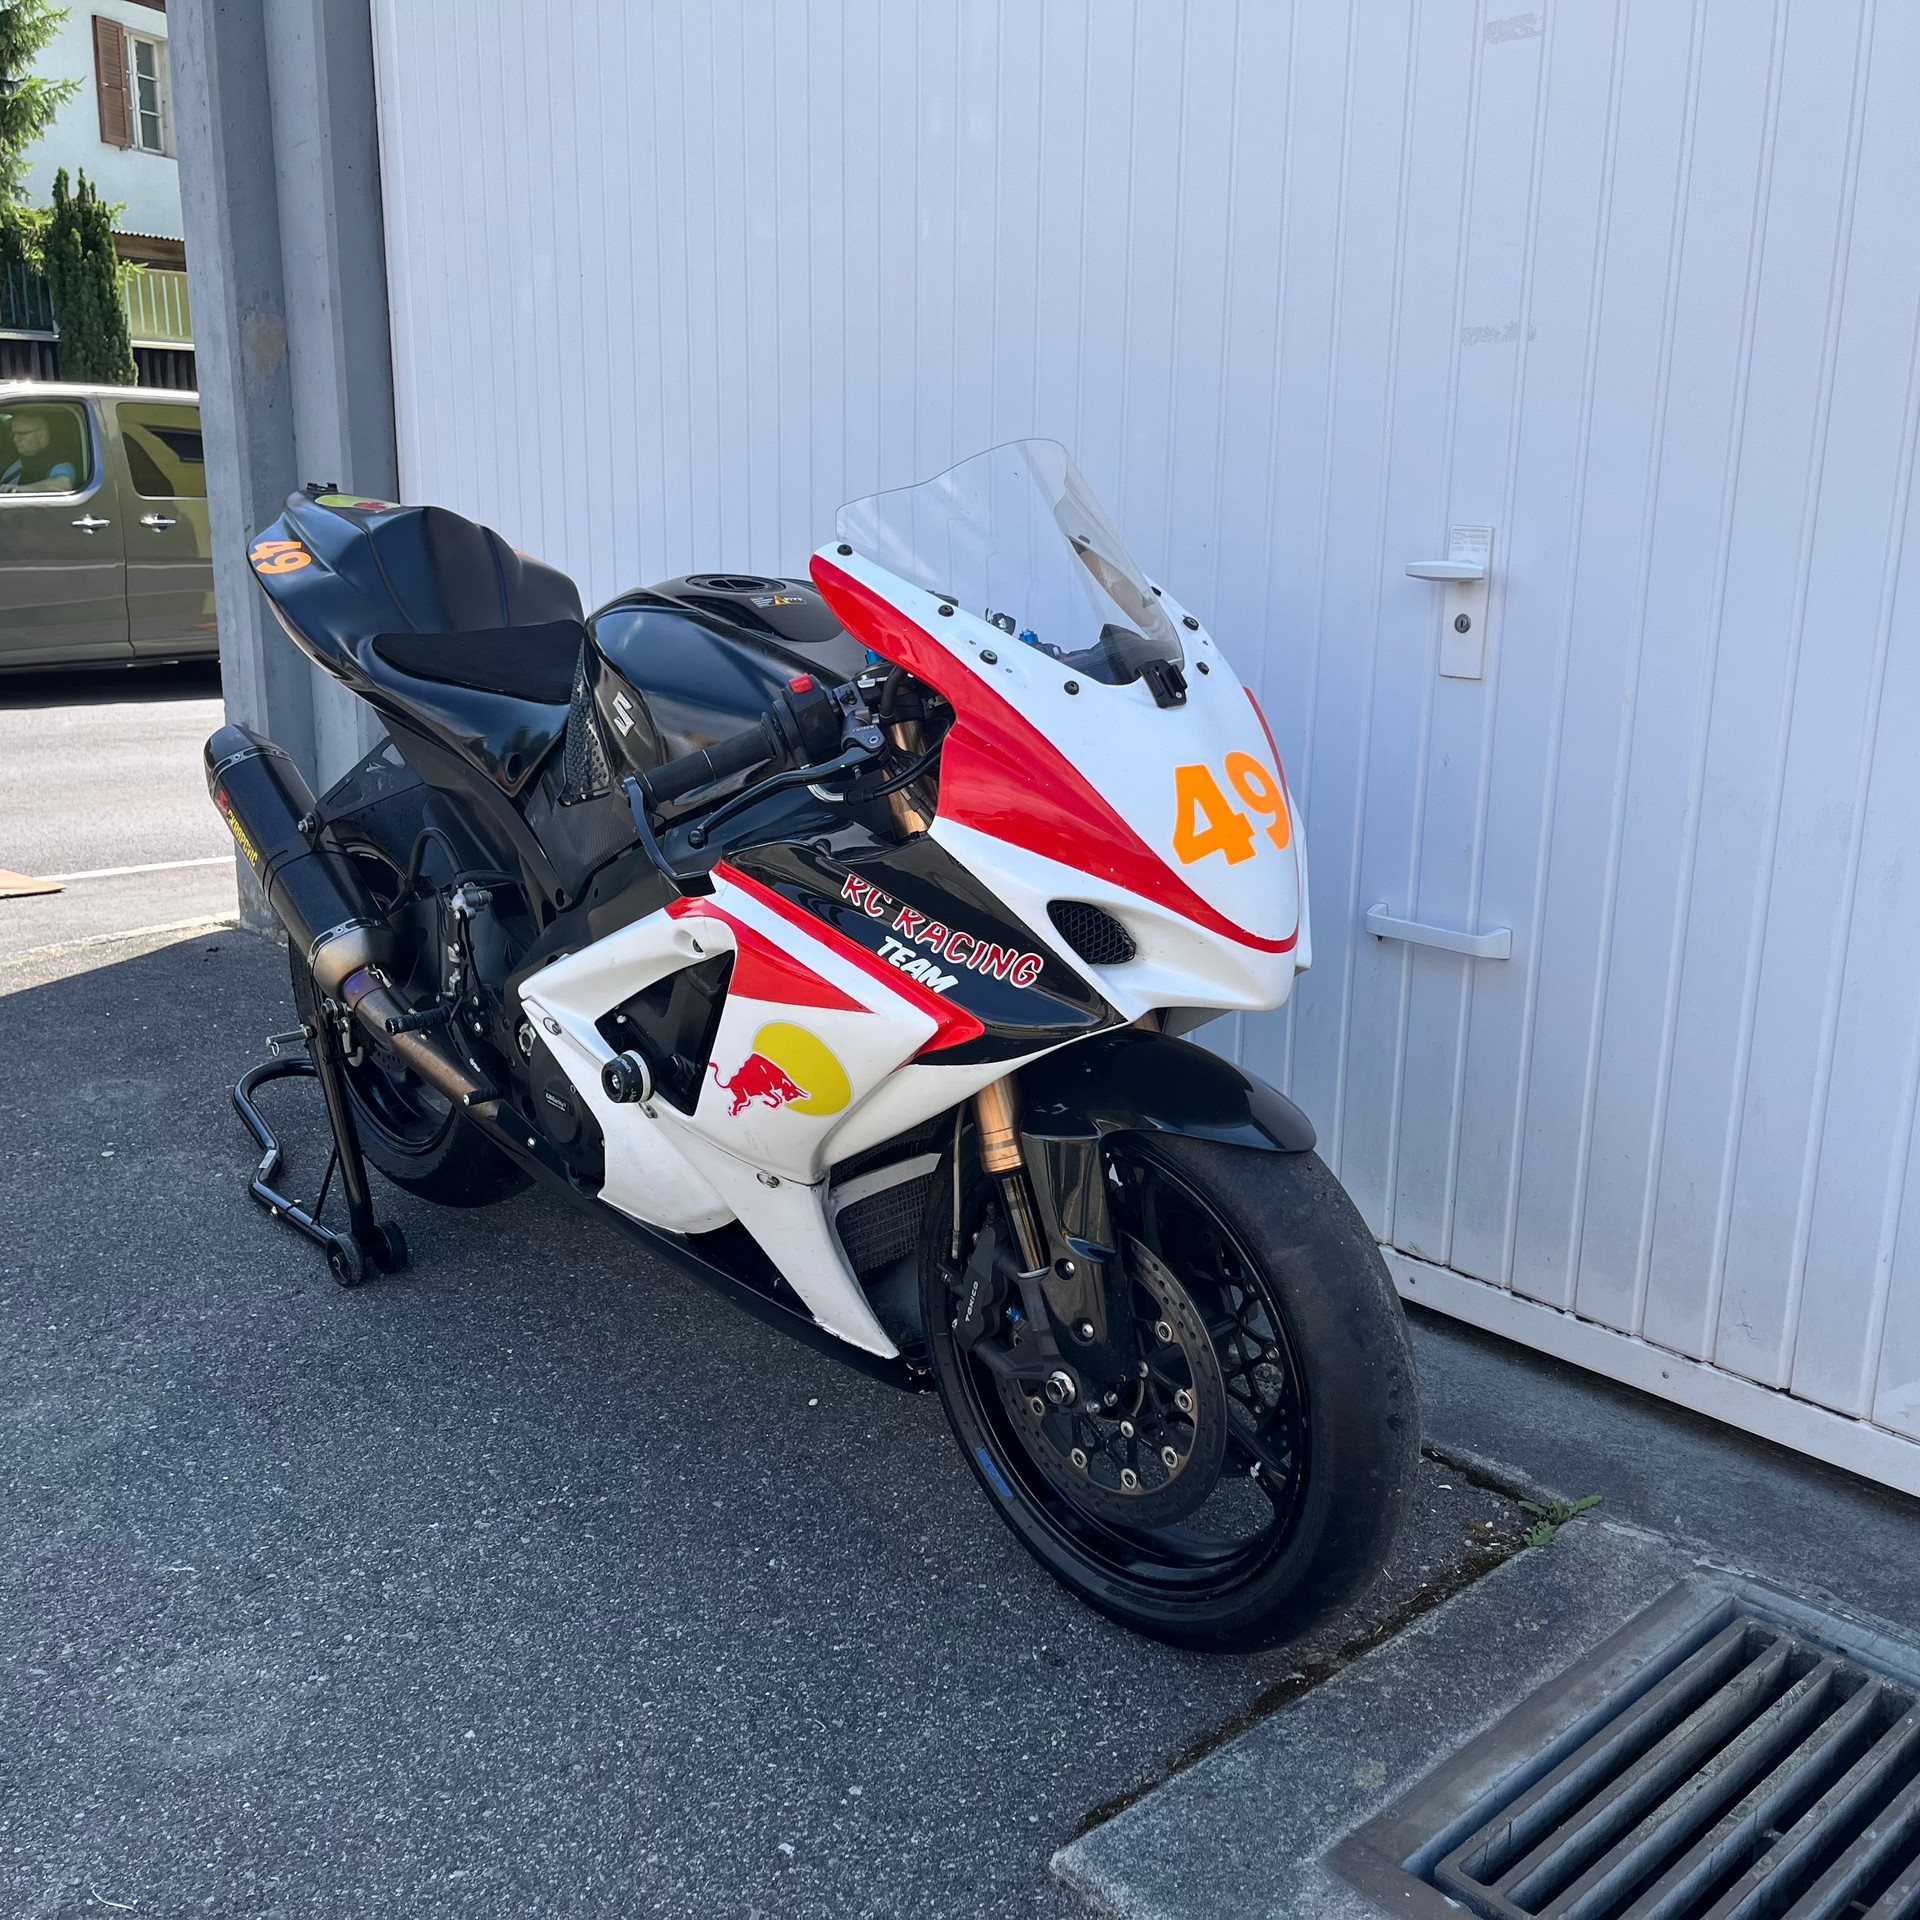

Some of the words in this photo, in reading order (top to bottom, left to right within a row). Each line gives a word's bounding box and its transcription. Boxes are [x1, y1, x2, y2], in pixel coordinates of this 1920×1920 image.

[250, 540, 313, 575] 49
[1171, 750, 1291, 868] 49
[841, 873, 893, 918] RC
[892, 906, 1045, 989] RACING
[876, 935, 959, 994] TEAM
[965, 1280, 979, 1322] TOKICO
